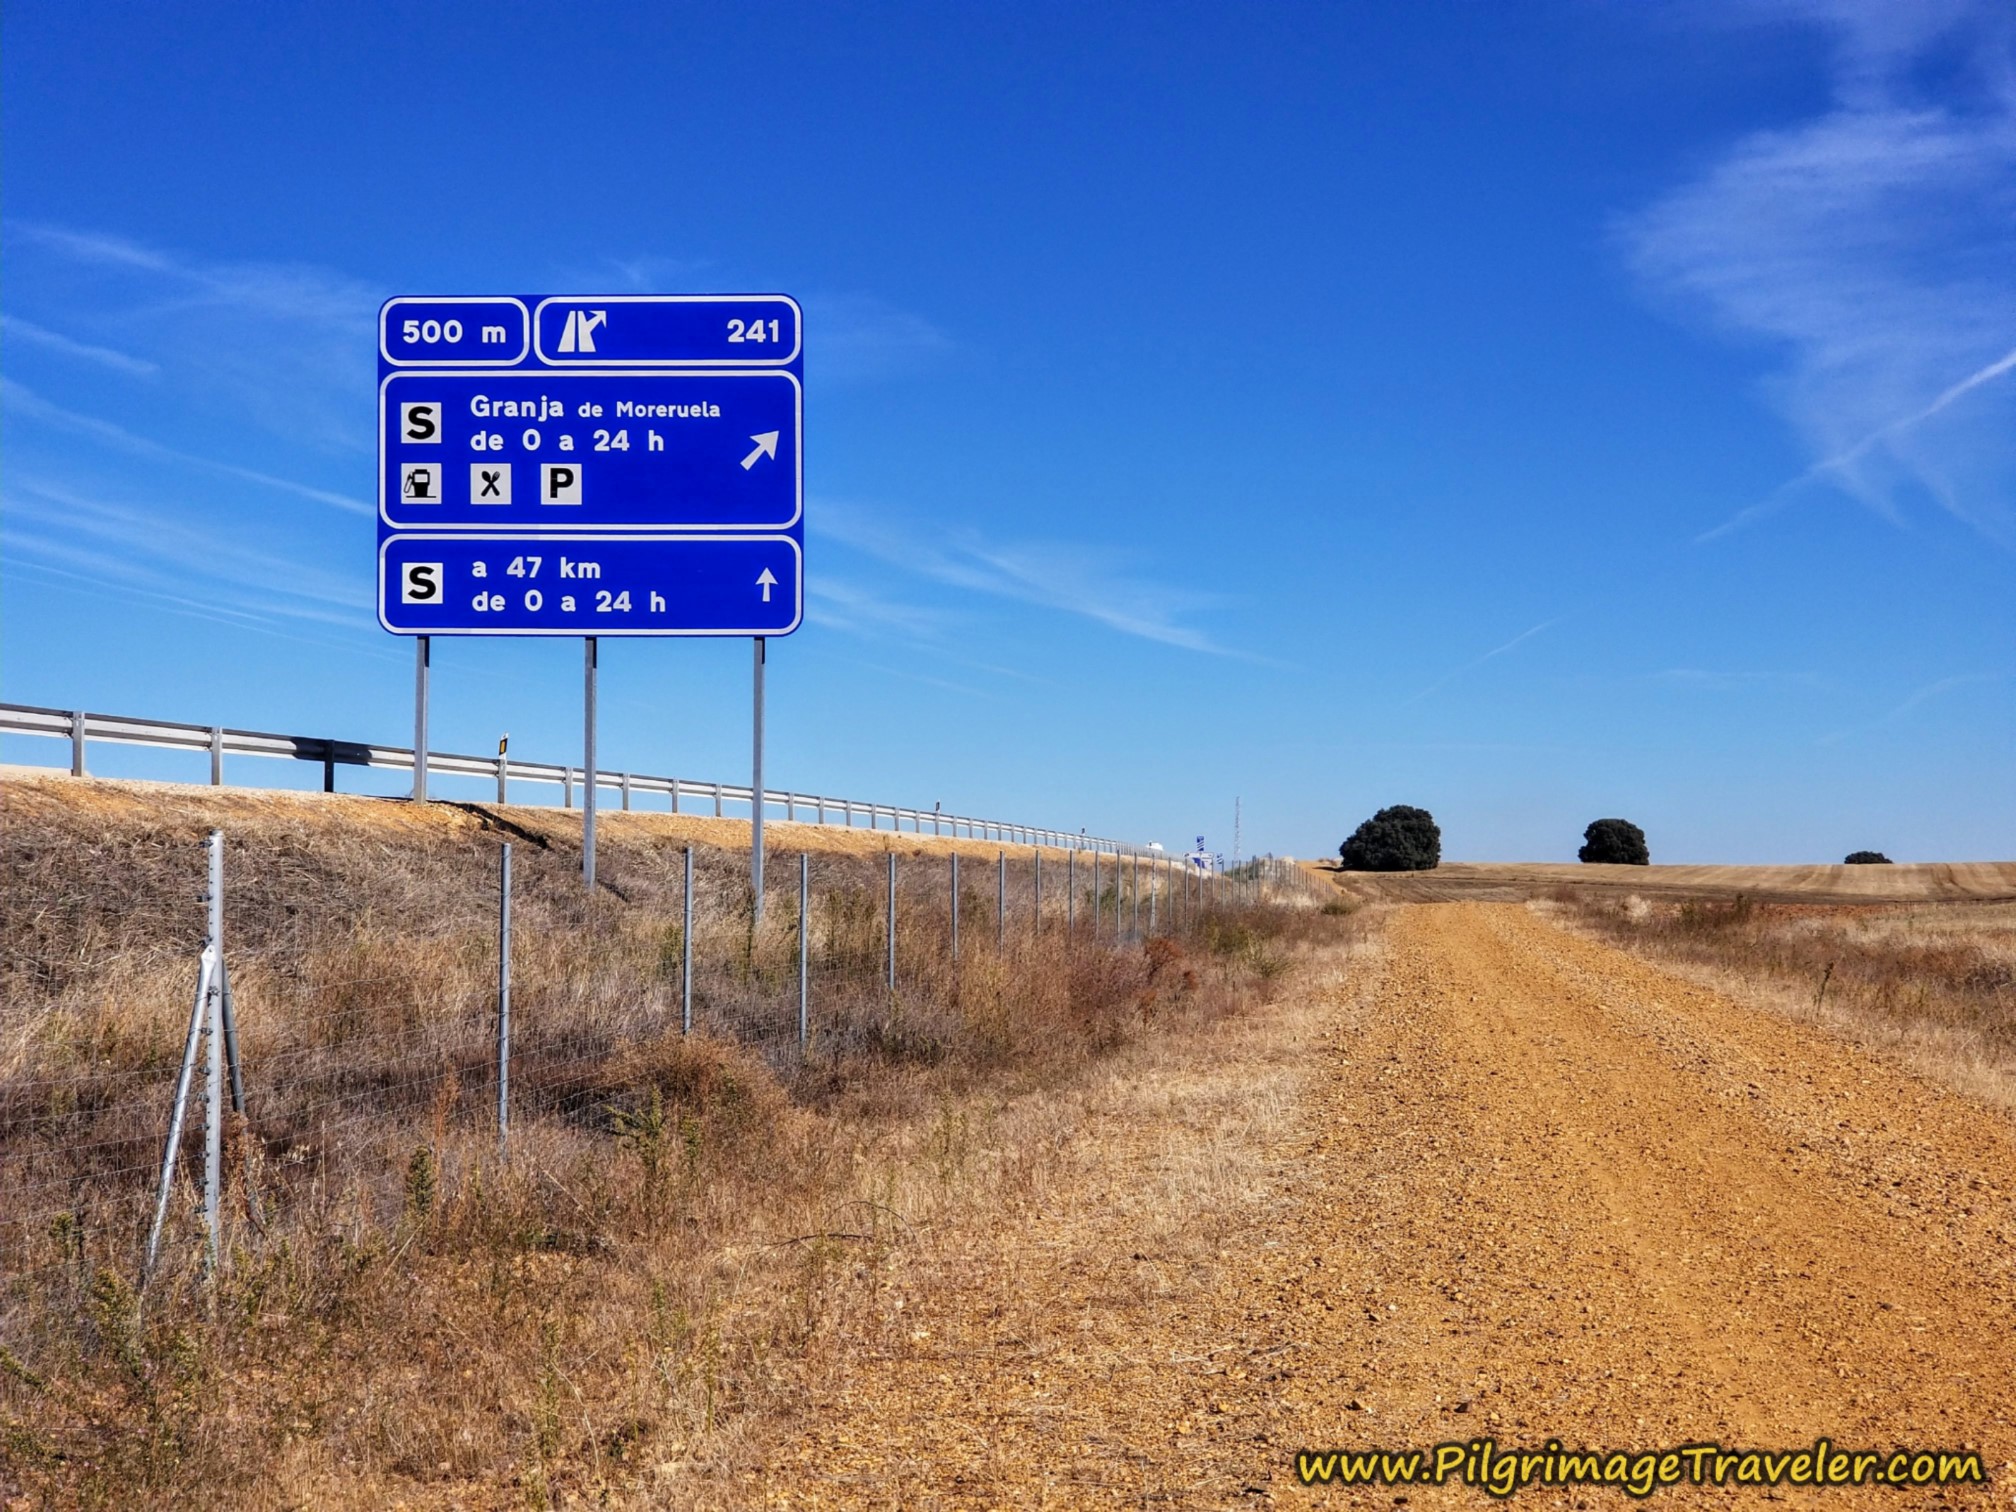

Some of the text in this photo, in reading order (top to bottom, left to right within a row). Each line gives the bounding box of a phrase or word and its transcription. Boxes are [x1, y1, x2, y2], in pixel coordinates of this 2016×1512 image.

[403, 320, 505, 343] 500 m
[727, 319, 778, 342] 241
[471, 395, 720, 422] Granja de Moreruela
[407, 406, 435, 439] S
[470, 429, 663, 451] de 0 a 24 h
[550, 468, 573, 498] P
[472, 557, 600, 578] a 47 km
[408, 566, 436, 599] S
[472, 590, 665, 612] de 0 a 24 h
